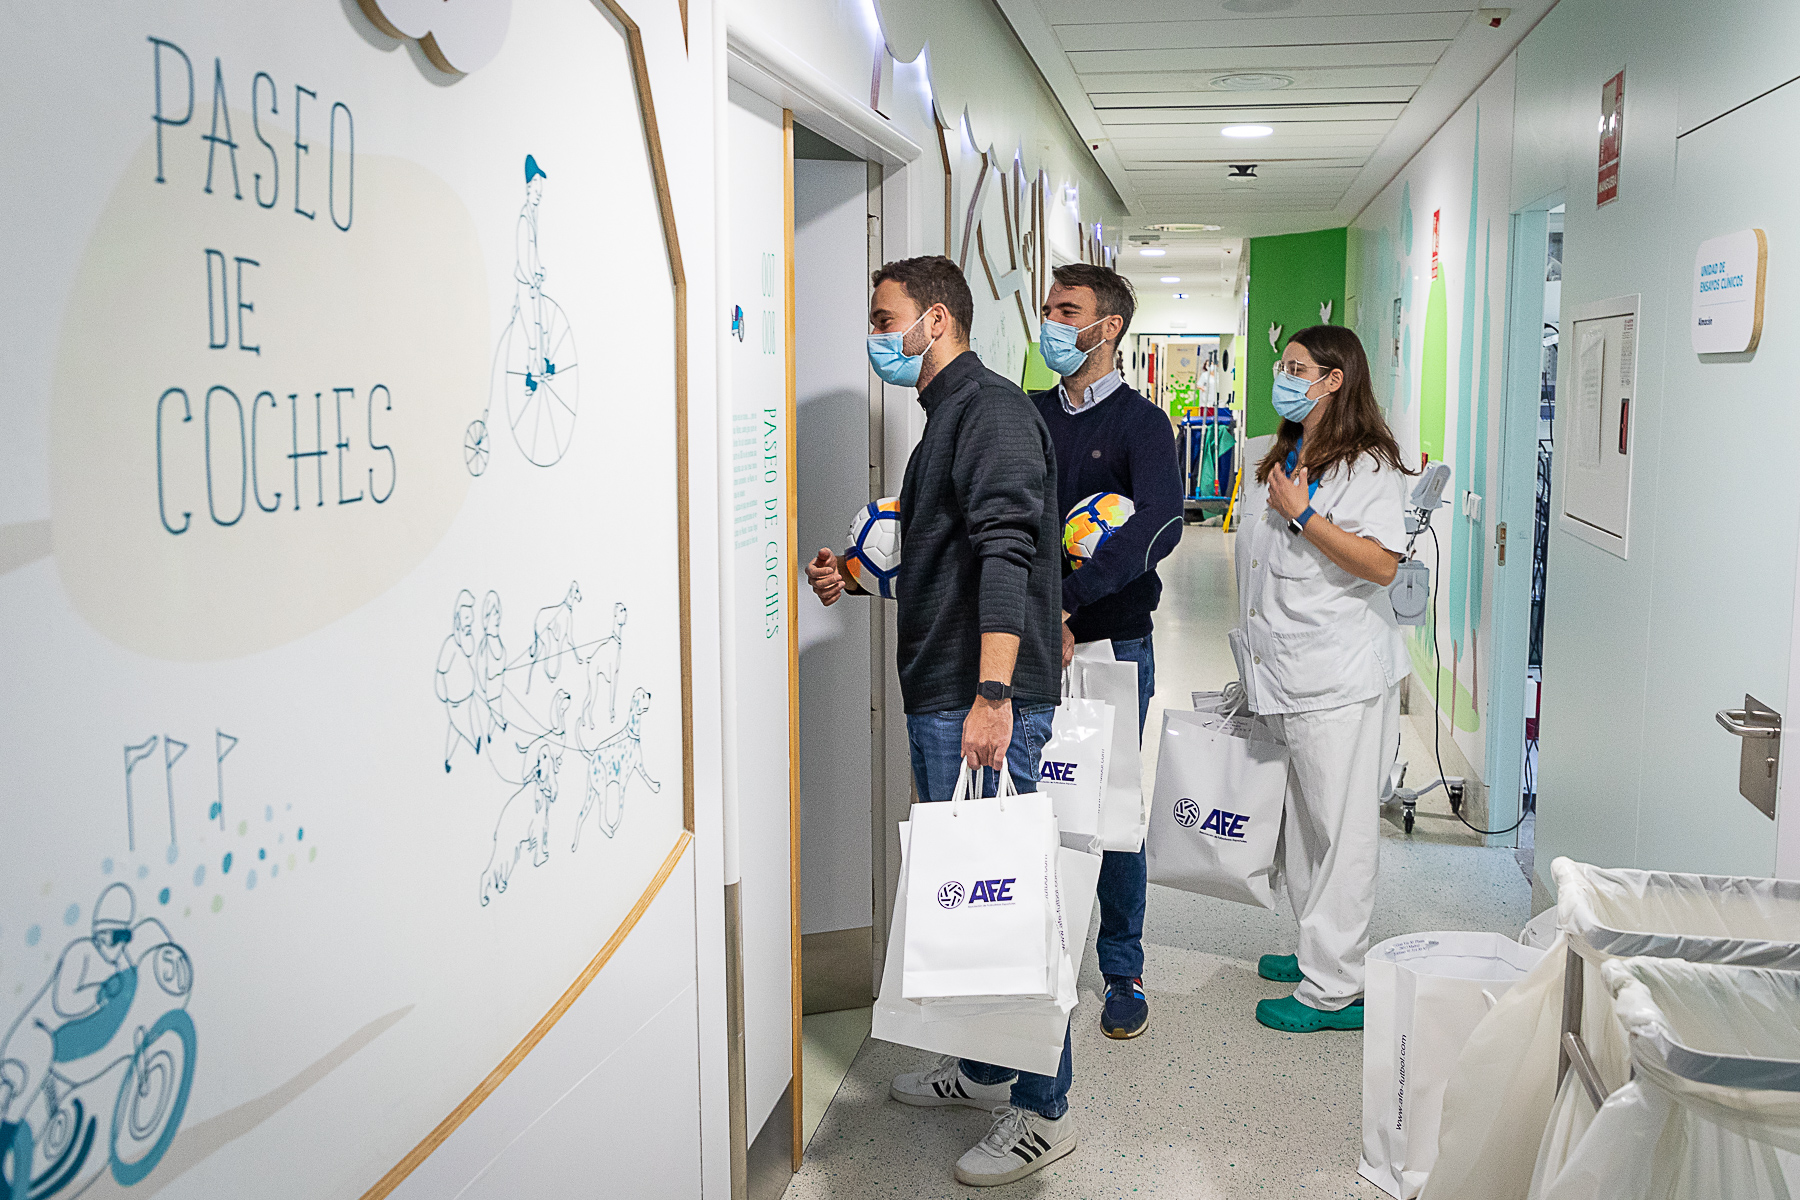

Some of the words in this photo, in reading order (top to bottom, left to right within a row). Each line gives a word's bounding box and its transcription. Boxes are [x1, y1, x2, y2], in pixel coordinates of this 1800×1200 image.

[147, 35, 354, 232] PASEO
[203, 247, 261, 356] DE
[1719, 262, 1725, 273] DE
[156, 383, 396, 536] COCHES
[763, 408, 778, 484] PASEO
[764, 498, 778, 529] DE
[764, 541, 780, 639] COCHES
[1040, 760, 1078, 782] AFE
[1199, 808, 1251, 839] AFE
[968, 877, 1017, 904] AFE
[1394, 1033, 1407, 1131] www.afe-futbol.com
